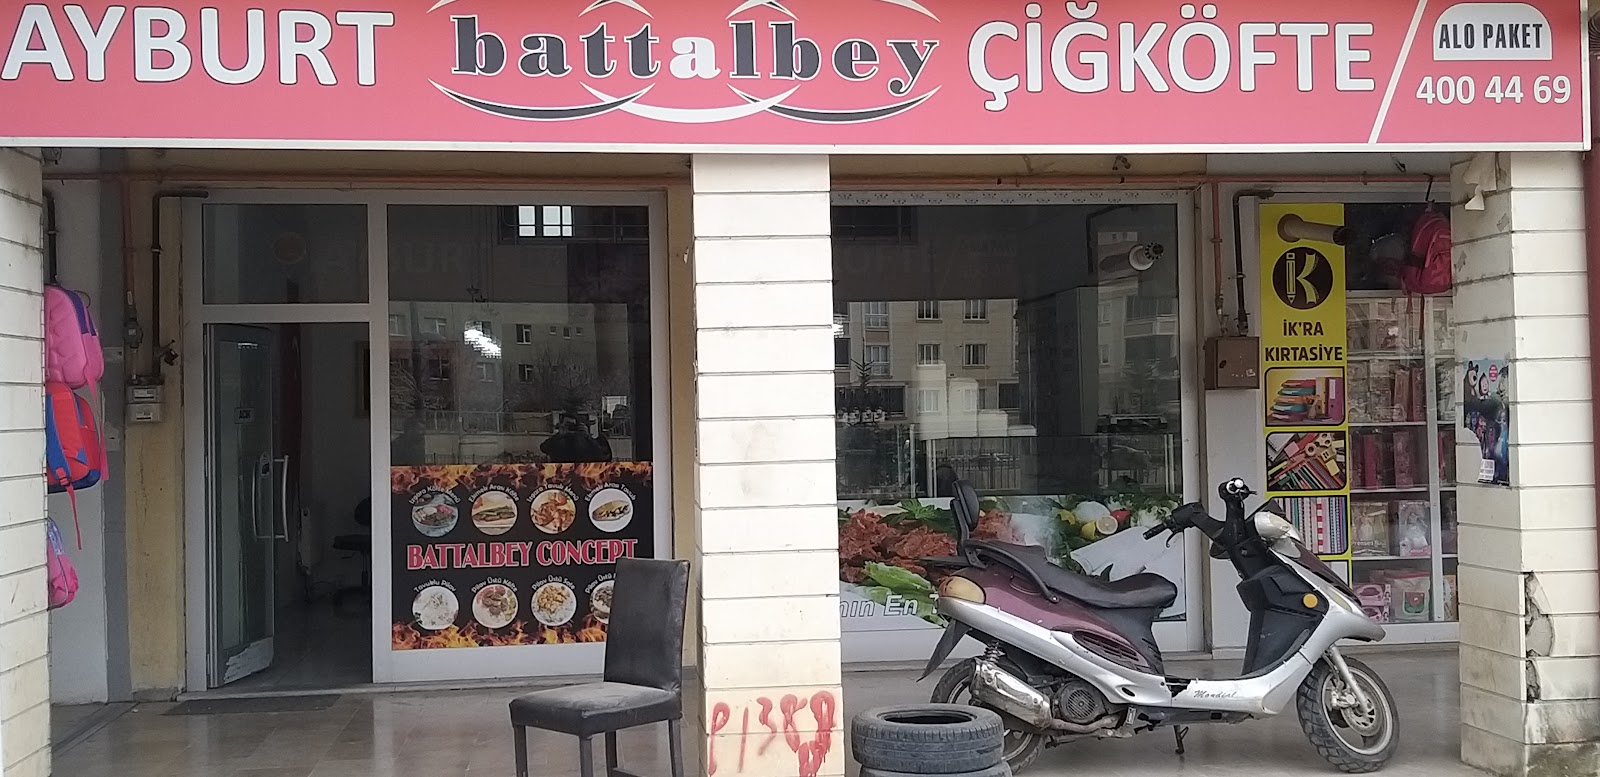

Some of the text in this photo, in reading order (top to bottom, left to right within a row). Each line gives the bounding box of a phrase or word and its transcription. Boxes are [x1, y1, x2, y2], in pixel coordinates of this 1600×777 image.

[0, 4, 395, 86] AYBURT
[1438, 23, 1543, 49] ALO PAKET
[450, 15, 939, 96] battalbey
[967, 1, 1376, 112] ÇİĞKÖFTE
[1416, 75, 1571, 104] 400 44 69
[1283, 319, 1324, 337] İK'RA
[1265, 344, 1343, 362] KIRTASİYE
[407, 539, 638, 570] BATTALBEY CONCEPT
[883, 594, 918, 616] En
